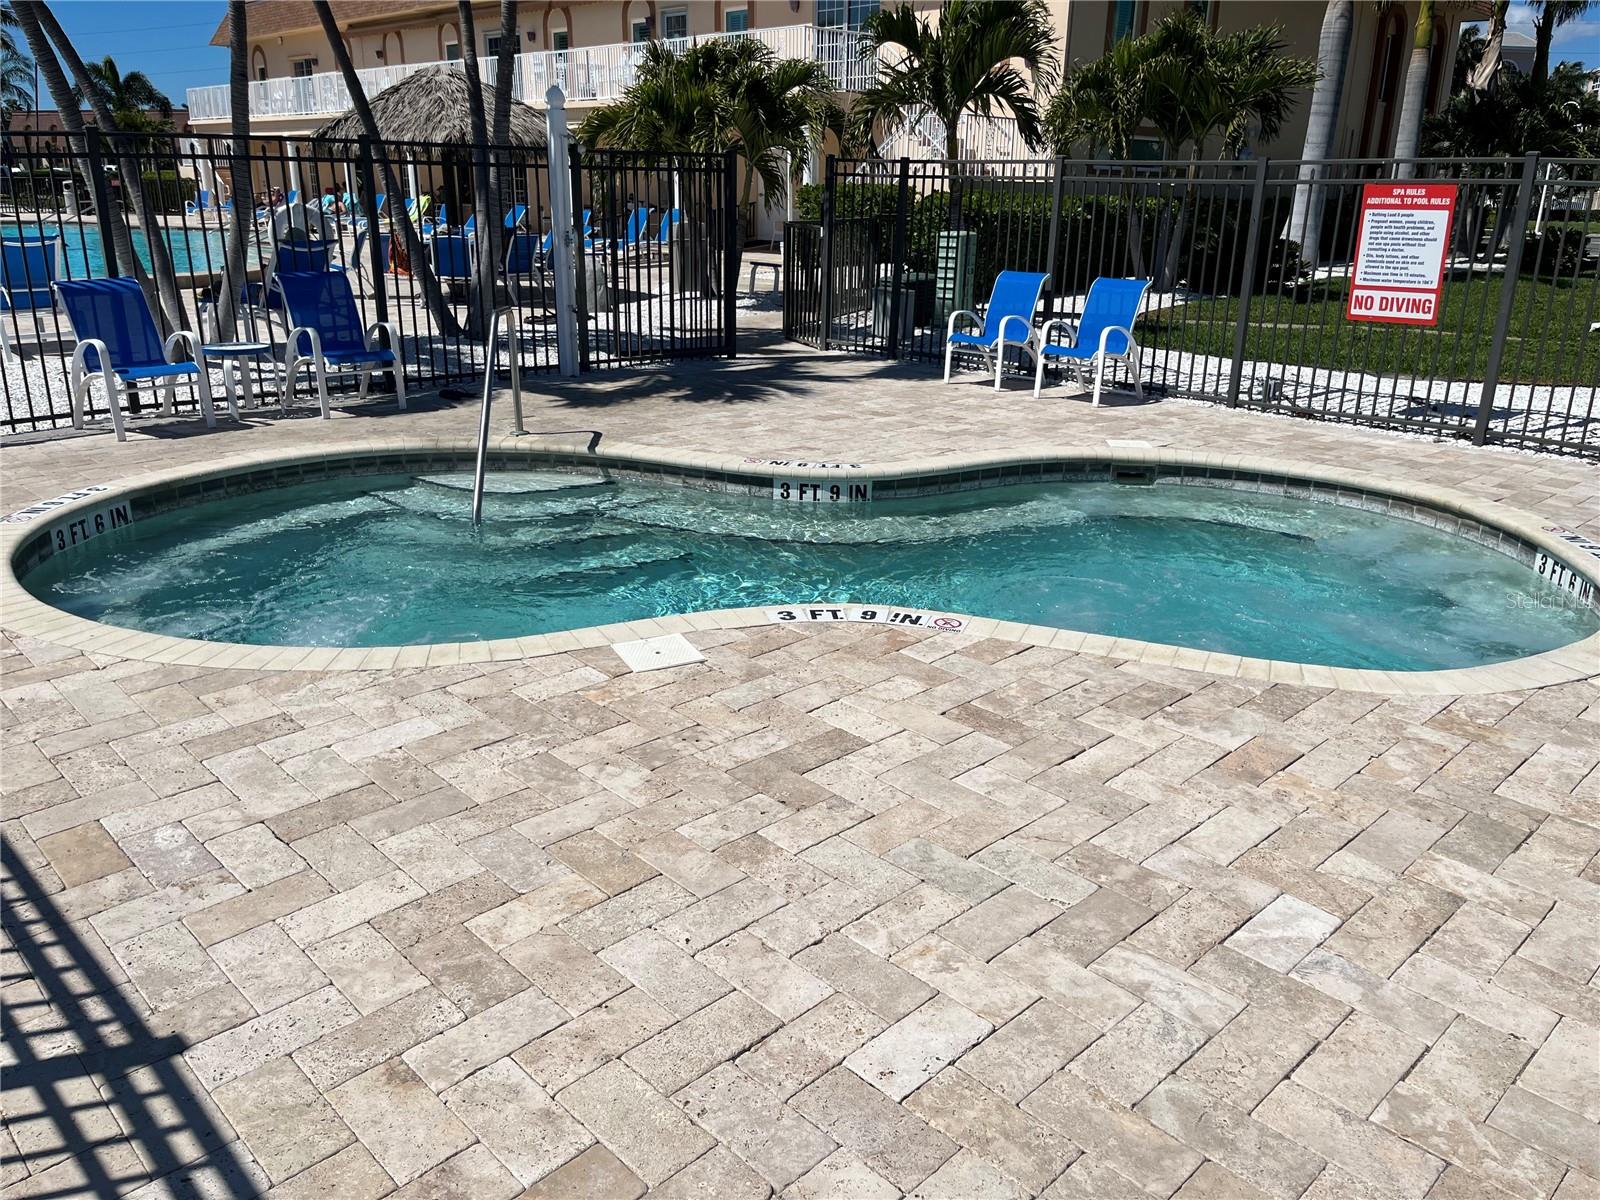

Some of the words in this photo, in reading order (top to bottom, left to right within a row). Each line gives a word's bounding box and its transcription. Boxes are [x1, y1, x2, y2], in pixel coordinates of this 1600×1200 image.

[1353, 295, 1374, 310] NO
[1378, 296, 1432, 314] DIVING
[780, 482, 790, 499] 3
[799, 484, 820, 501] FT.
[830, 484, 840, 501] 9
[850, 484, 870, 502] IN.
[56, 529, 66, 550] 3
[69, 519, 89, 544] FT.
[94, 512, 104, 534] 6
[110, 505, 132, 529] IN.
[1539, 554, 1548, 574] 3
[1568, 572, 1576, 593] 6
[777, 611, 796, 620] 3
[810, 610, 844, 620] FT.
[860, 610, 877, 620] 9
